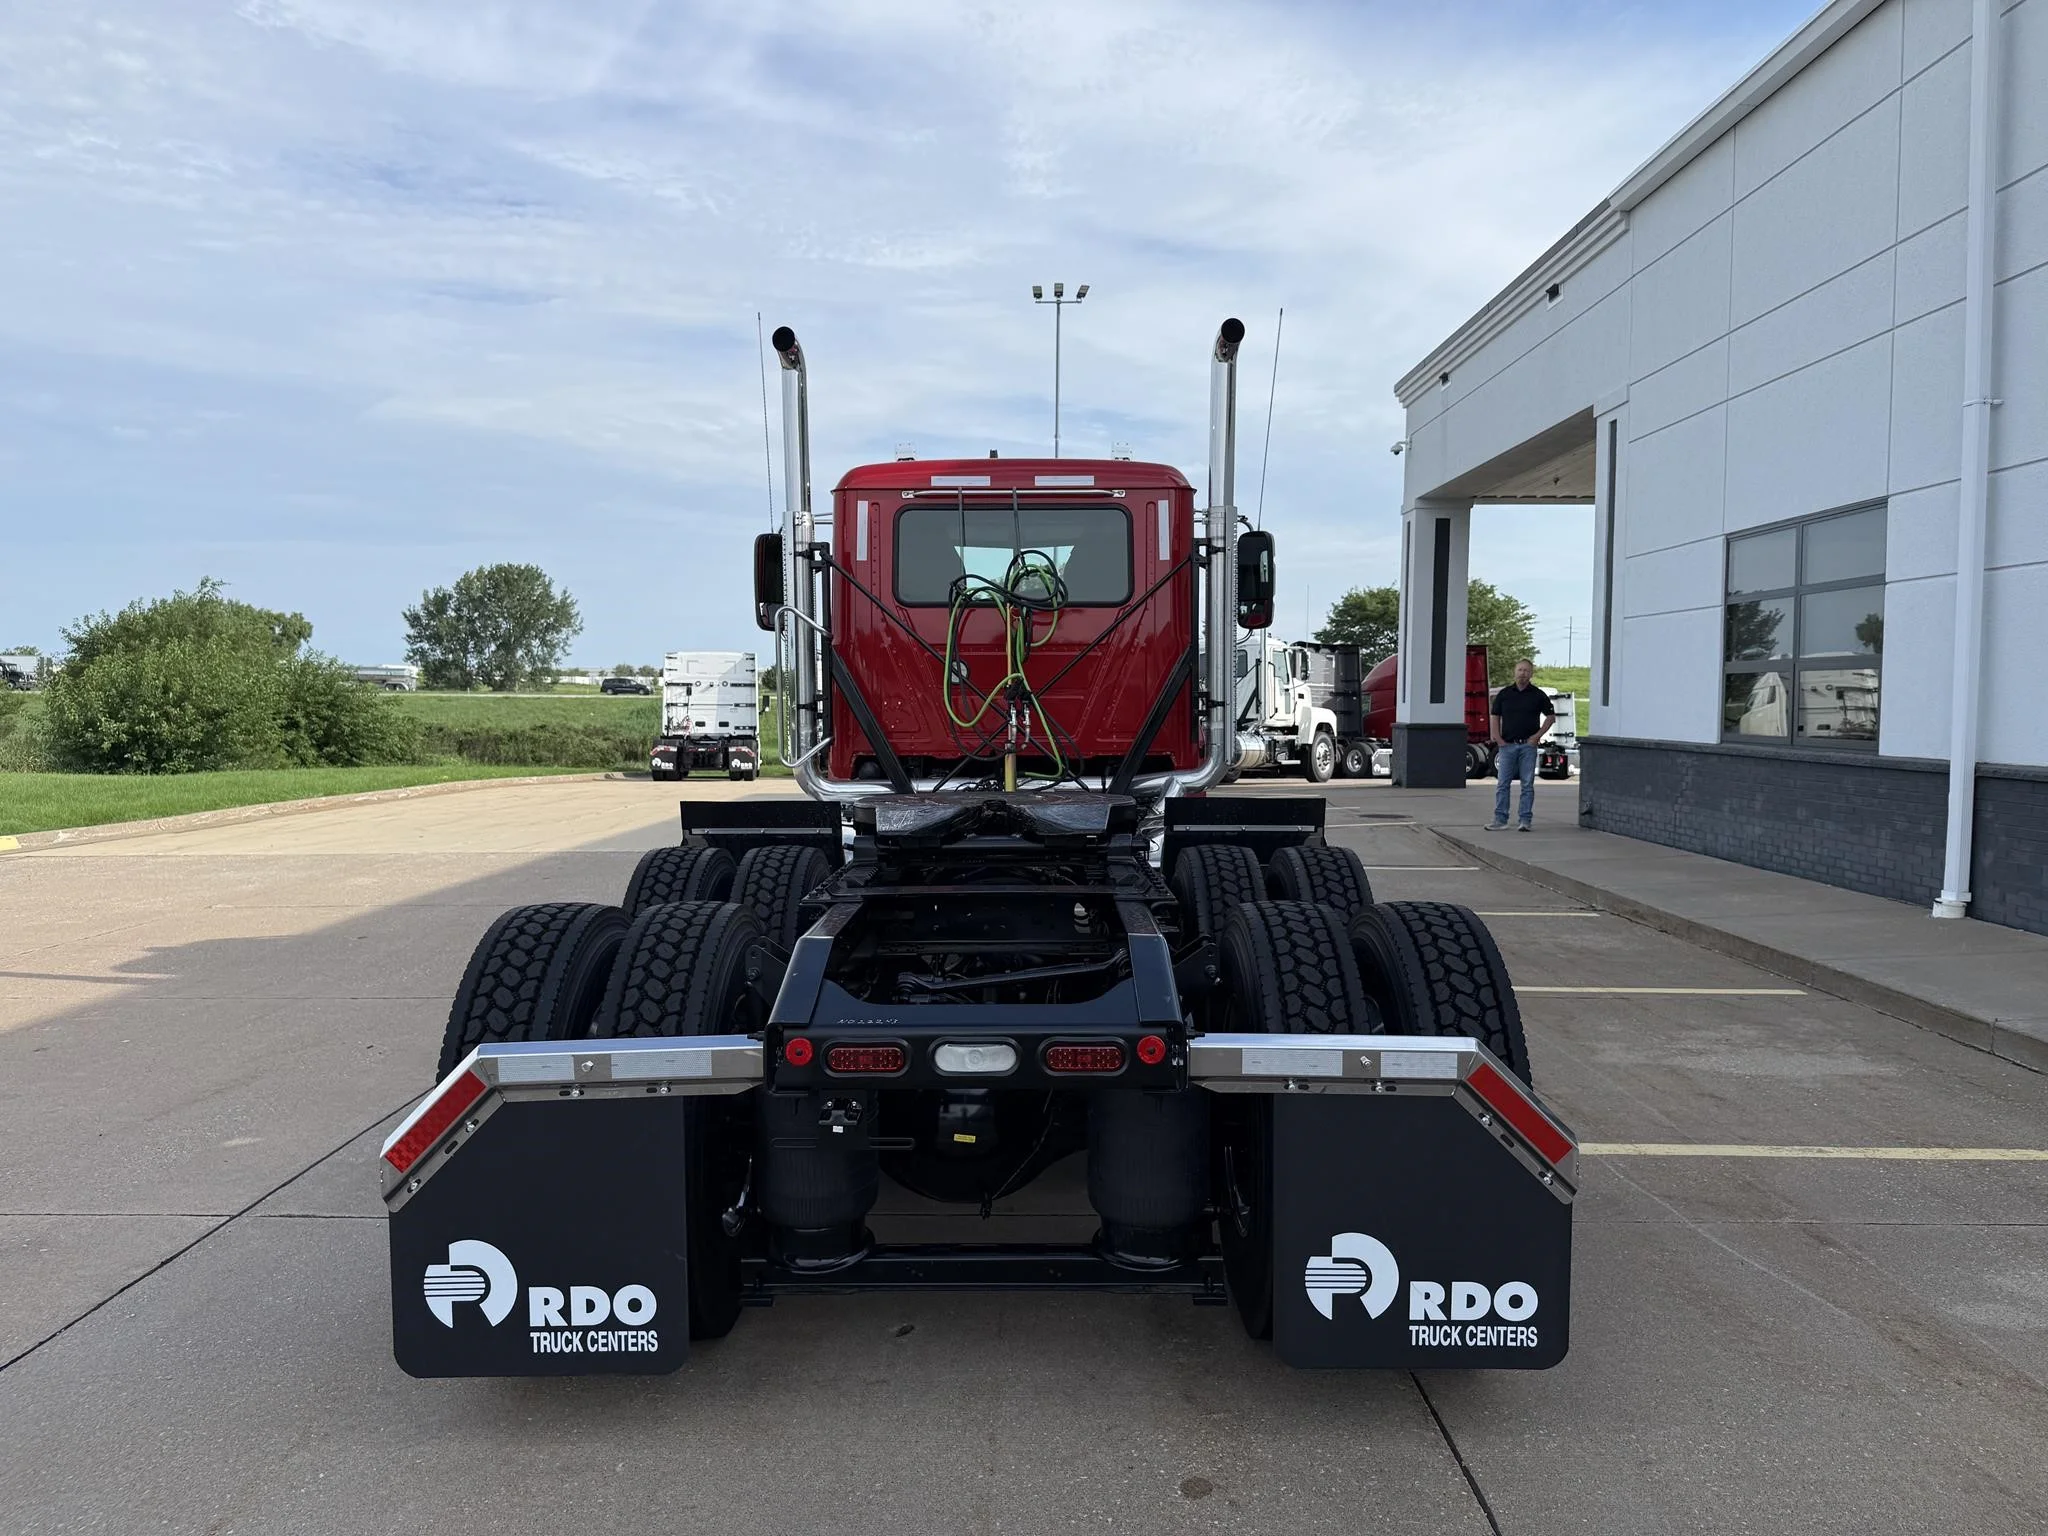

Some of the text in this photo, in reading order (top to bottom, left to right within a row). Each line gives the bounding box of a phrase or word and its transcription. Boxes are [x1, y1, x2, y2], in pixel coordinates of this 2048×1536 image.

[528, 1284, 657, 1326] RDO
[1409, 1281, 1538, 1321] RDO
[530, 1330, 658, 1353] TRUCK CENTERS
[1409, 1325, 1538, 1347] TRUCK CENTERS
